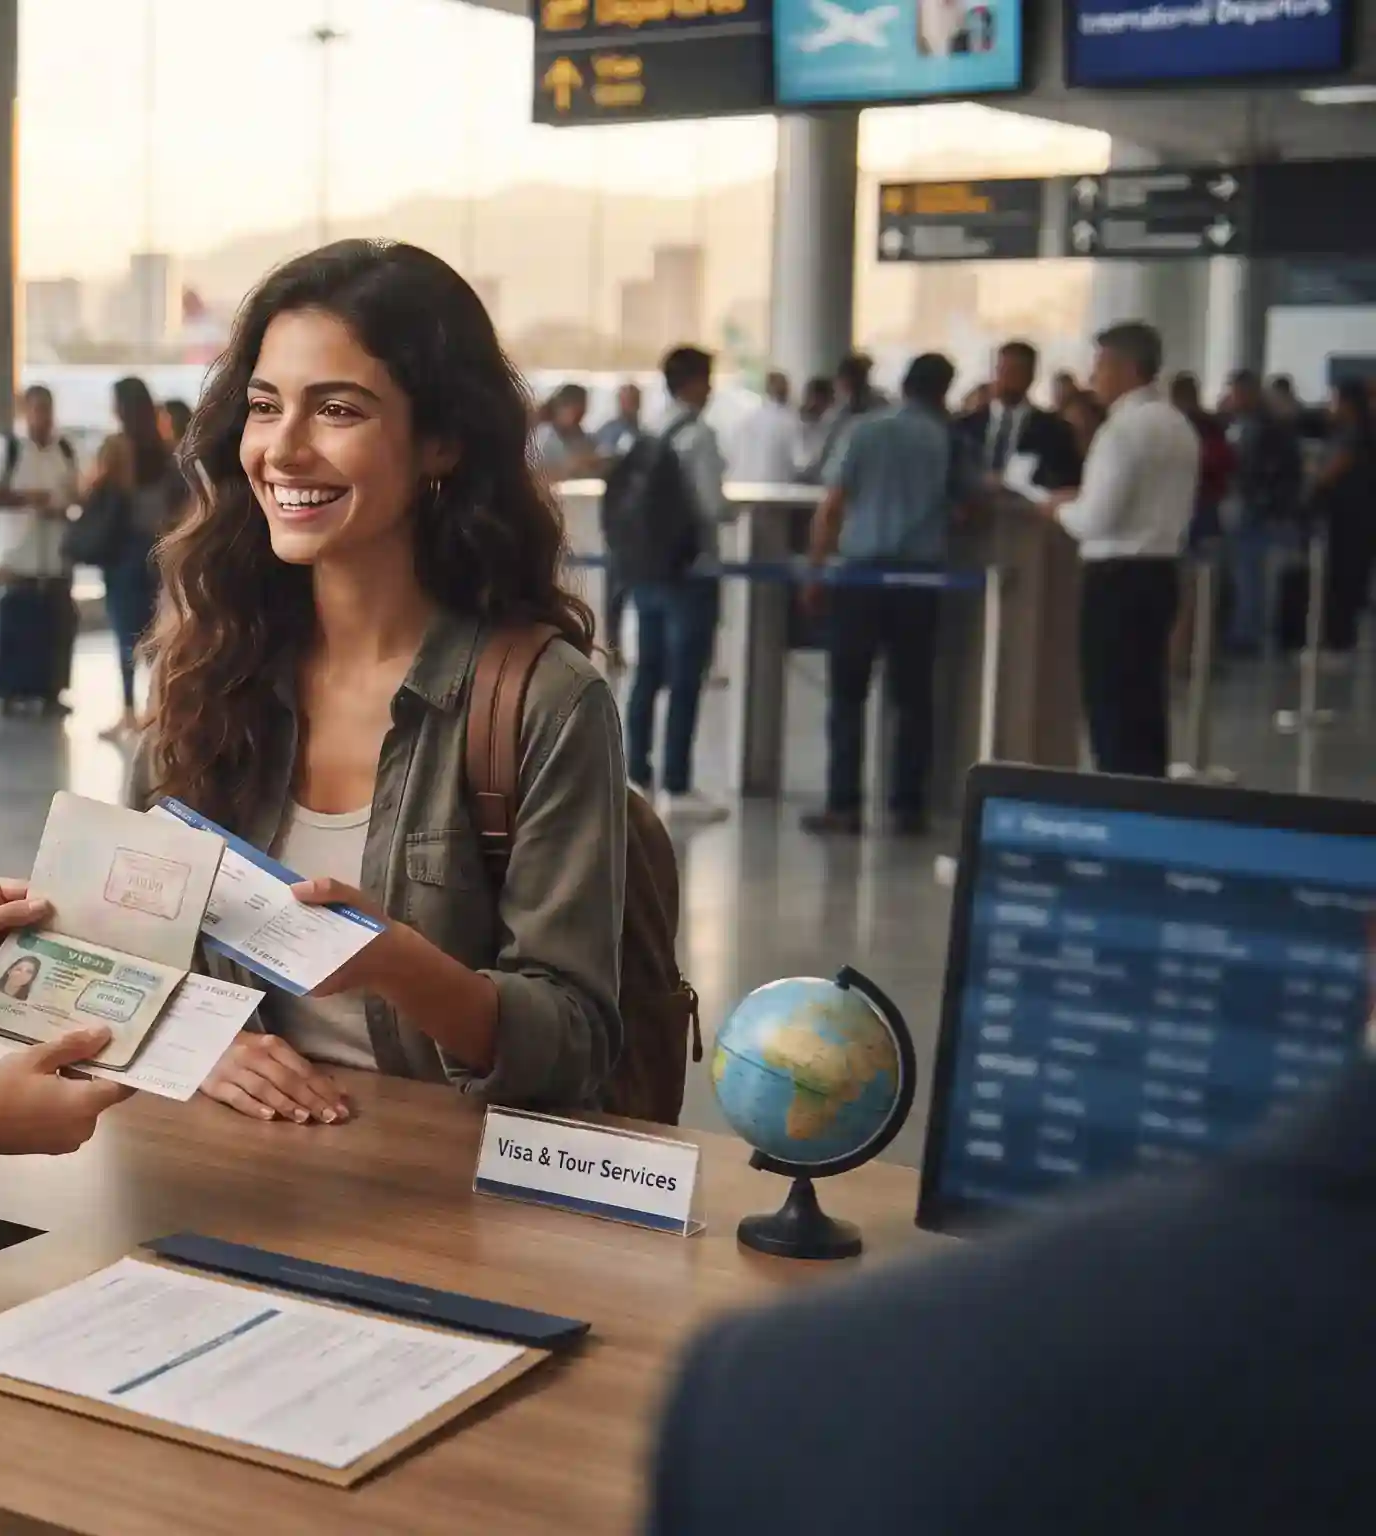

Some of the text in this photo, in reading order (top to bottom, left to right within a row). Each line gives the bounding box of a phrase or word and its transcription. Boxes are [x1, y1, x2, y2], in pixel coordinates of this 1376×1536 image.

[498, 1137, 677, 1192] Visa & Tour Services
